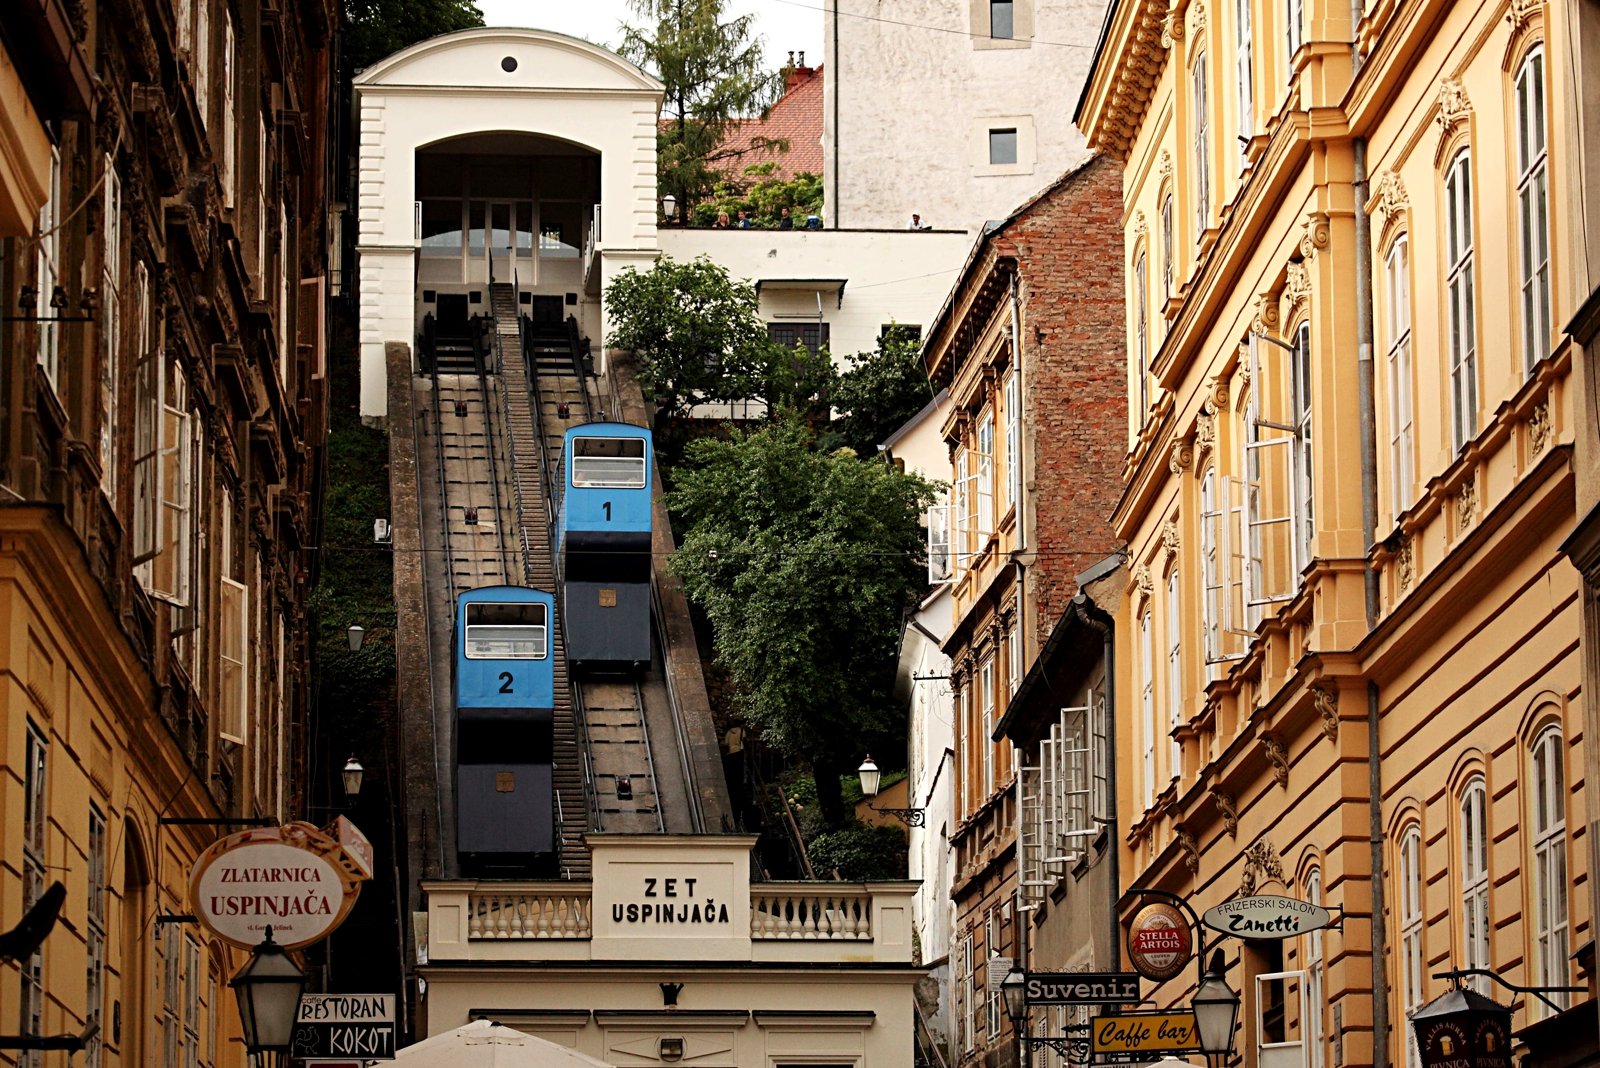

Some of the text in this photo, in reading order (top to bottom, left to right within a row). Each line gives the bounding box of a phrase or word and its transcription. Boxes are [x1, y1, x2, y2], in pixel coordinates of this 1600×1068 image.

[602, 501, 612, 522] 1
[498, 671, 514, 694] 2
[220, 867, 321, 883] ZLATARNICA
[644, 878, 697, 897] ZET
[210, 889, 332, 917] USPINJAČA
[612, 898, 729, 923] USPINJAČA
[1216, 899, 1316, 916] FRIZERSKI SALON
[1228, 914, 1299, 932] Zanetti
[1139, 931, 1179, 941] STELLA
[1140, 940, 1181, 949] ARTOIS
[1026, 978, 1138, 999] Suvenir
[301, 997, 386, 1019] RESTORAN
[330, 1026, 393, 1056] KOKOT
[1098, 1019, 1195, 1048] Caffe bar
